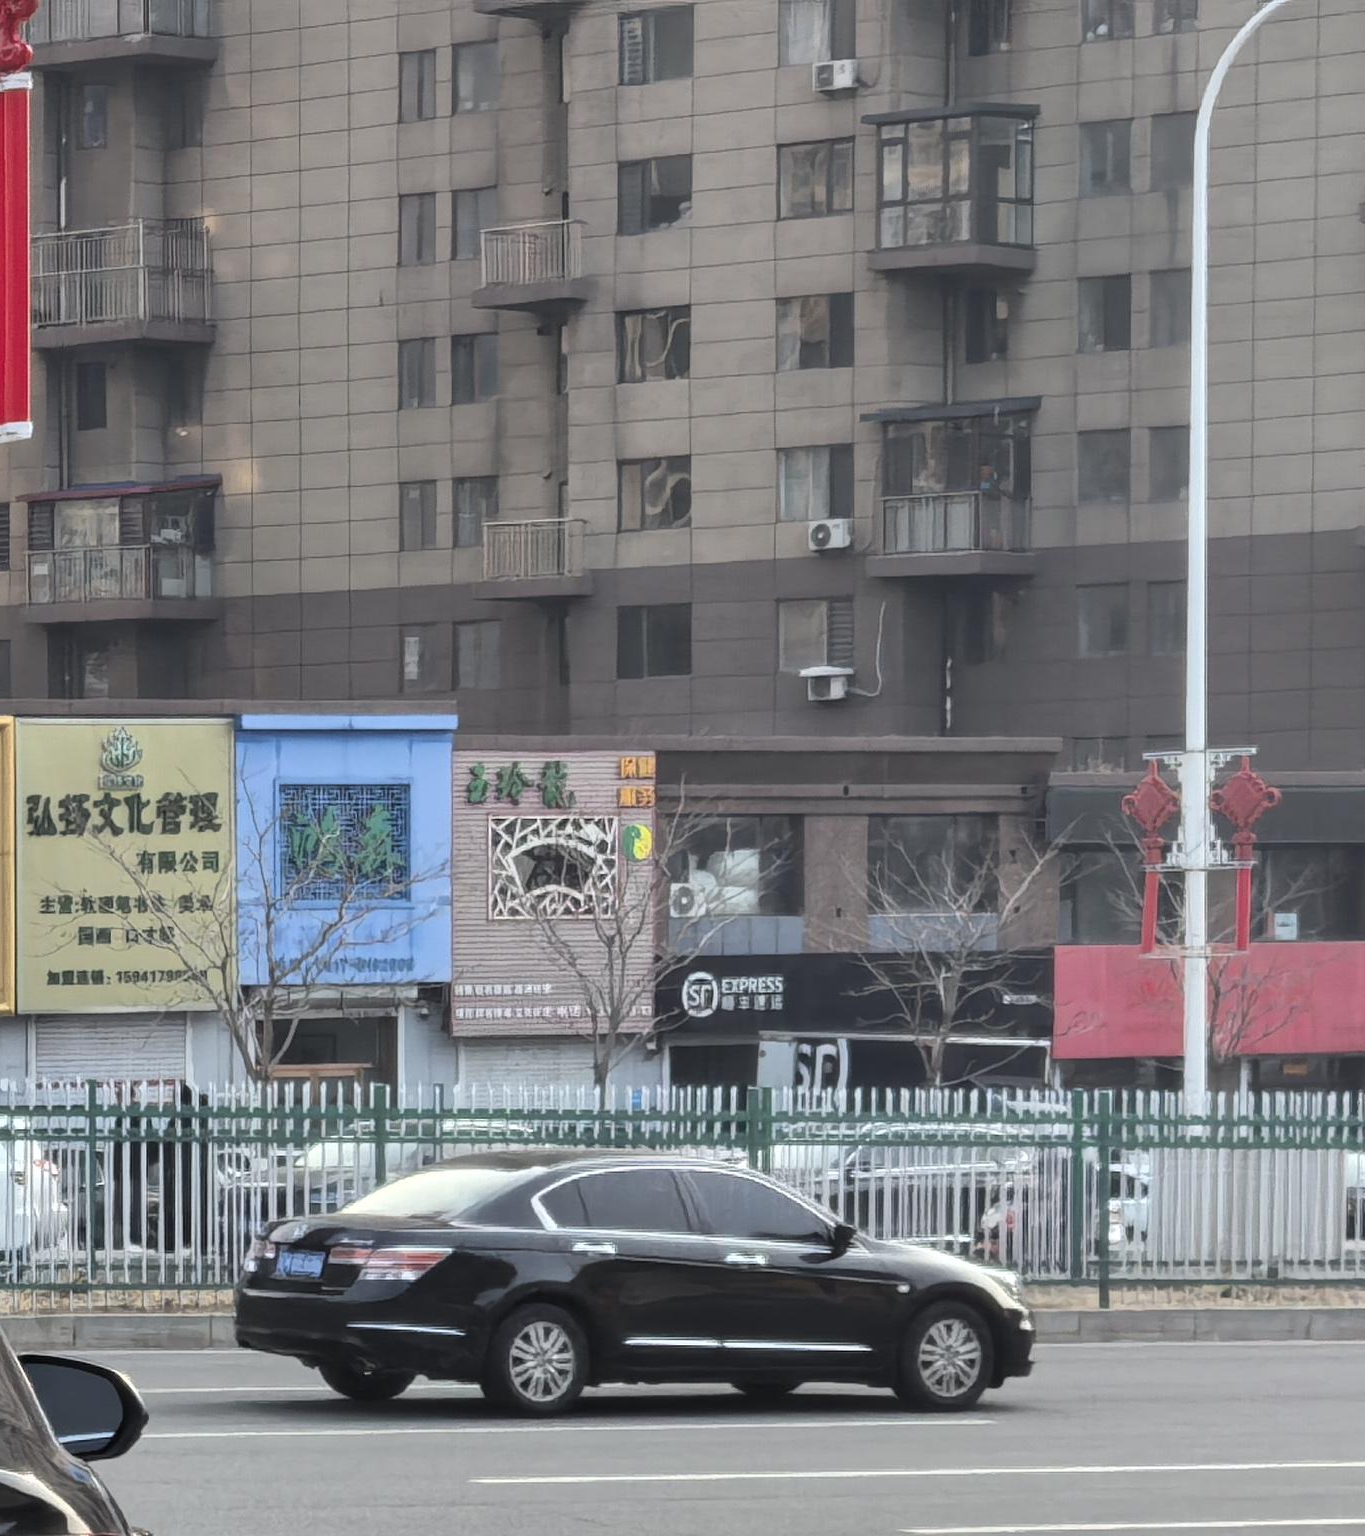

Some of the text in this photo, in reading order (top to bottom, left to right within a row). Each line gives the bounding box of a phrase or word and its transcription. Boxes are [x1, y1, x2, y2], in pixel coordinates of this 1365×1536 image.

[26, 791, 223, 837] 弘扬文化管理
[136, 850, 220, 874] 有限公司
[721, 976, 784, 994] EXPRESS
